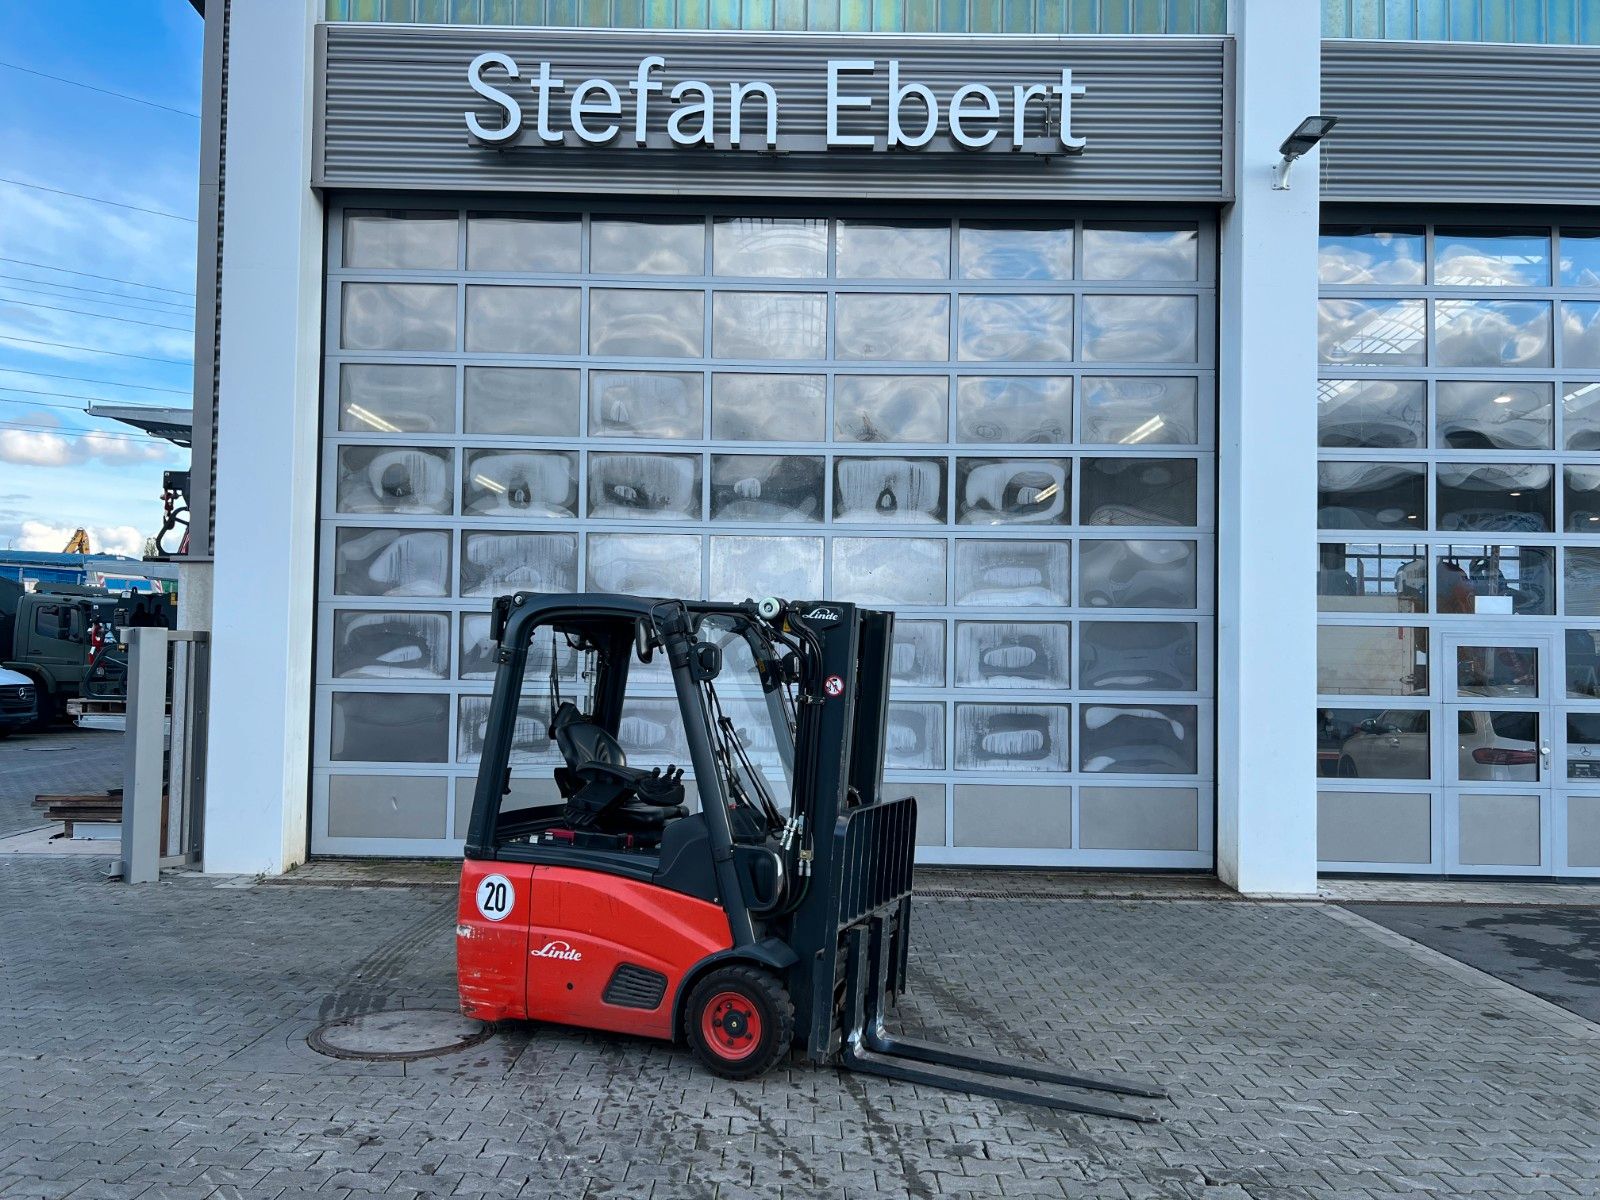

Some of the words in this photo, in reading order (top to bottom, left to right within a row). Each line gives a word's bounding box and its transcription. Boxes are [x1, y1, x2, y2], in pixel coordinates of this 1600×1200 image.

[464, 52, 778, 147] Stefan
[826, 60, 1087, 149] Ebert
[802, 607, 839, 621] Linde
[483, 881, 507, 913] 20
[531, 940, 582, 962] Linde
